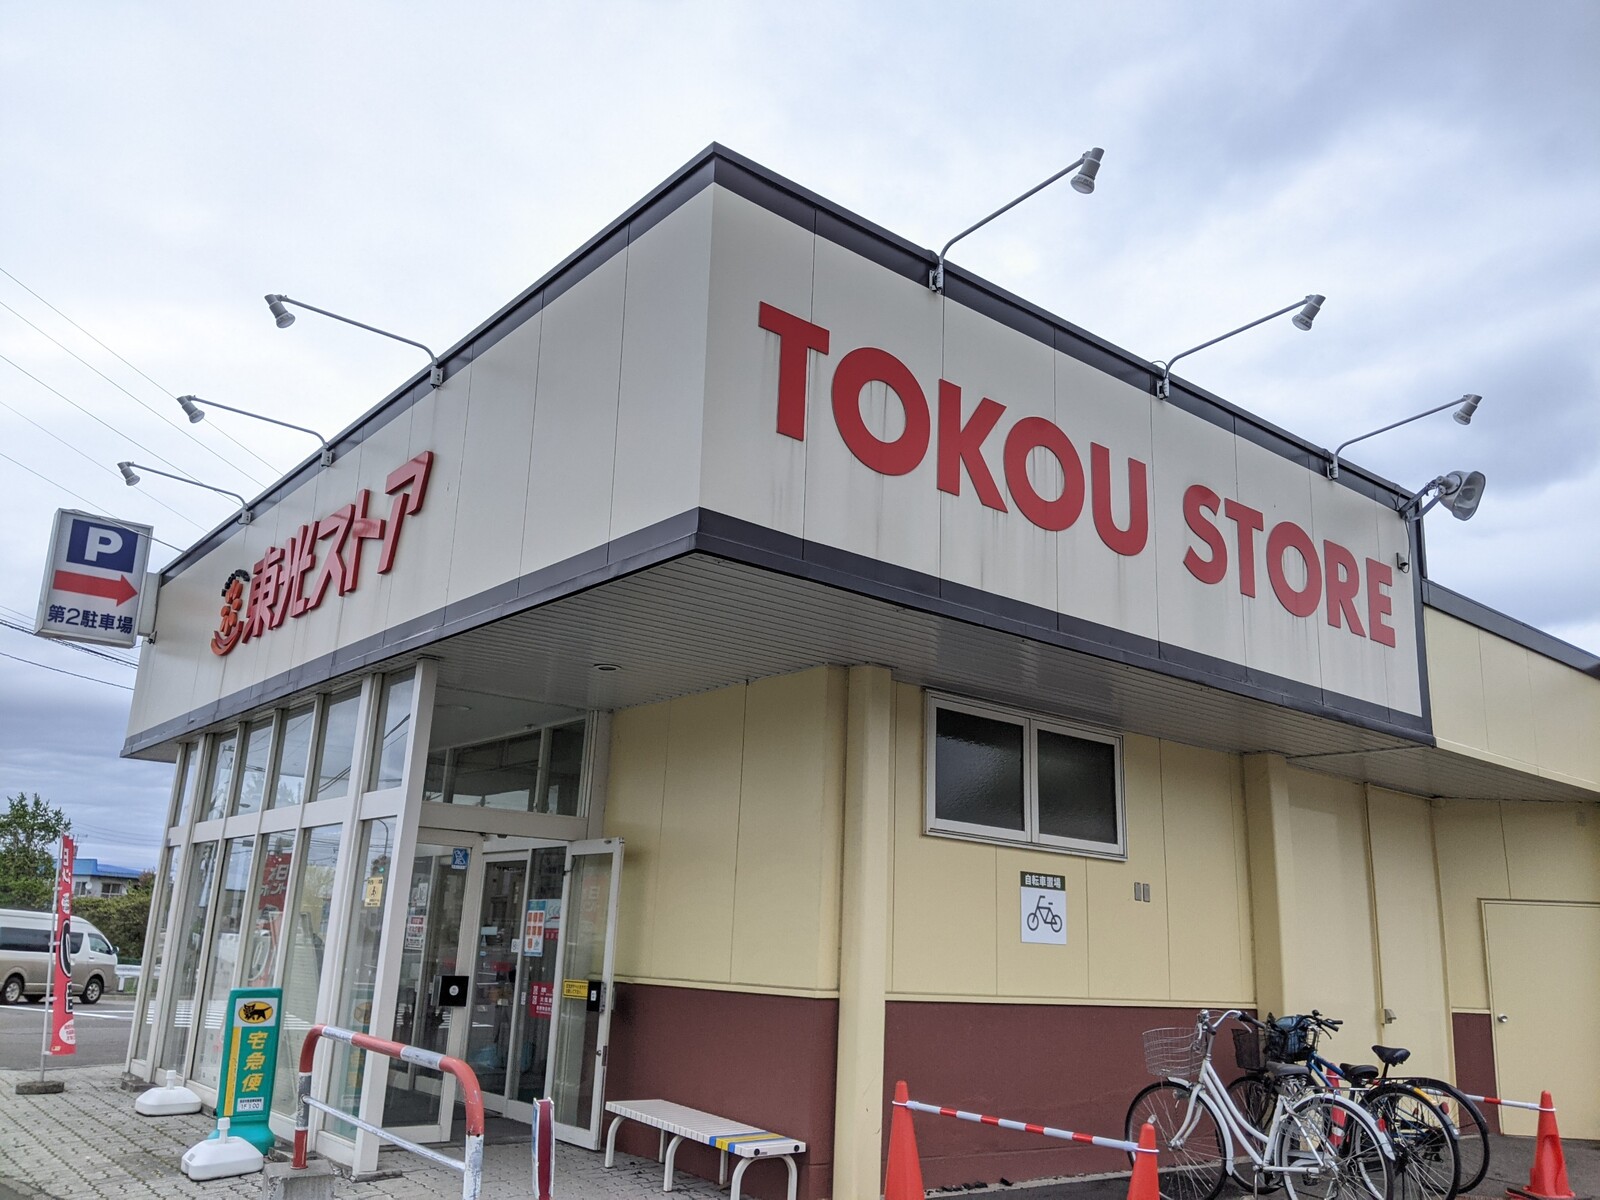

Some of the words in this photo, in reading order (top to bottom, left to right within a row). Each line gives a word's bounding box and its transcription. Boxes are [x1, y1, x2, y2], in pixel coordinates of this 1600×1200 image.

[758, 301, 1148, 556] TOKOU
[1183, 484, 1395, 648] STORE
[84, 526, 123, 562] P
[241, 450, 434, 644] 東光ストア
[47, 604, 133, 634] 第2駐車場
[241, 1031, 269, 1092] 宅急便
